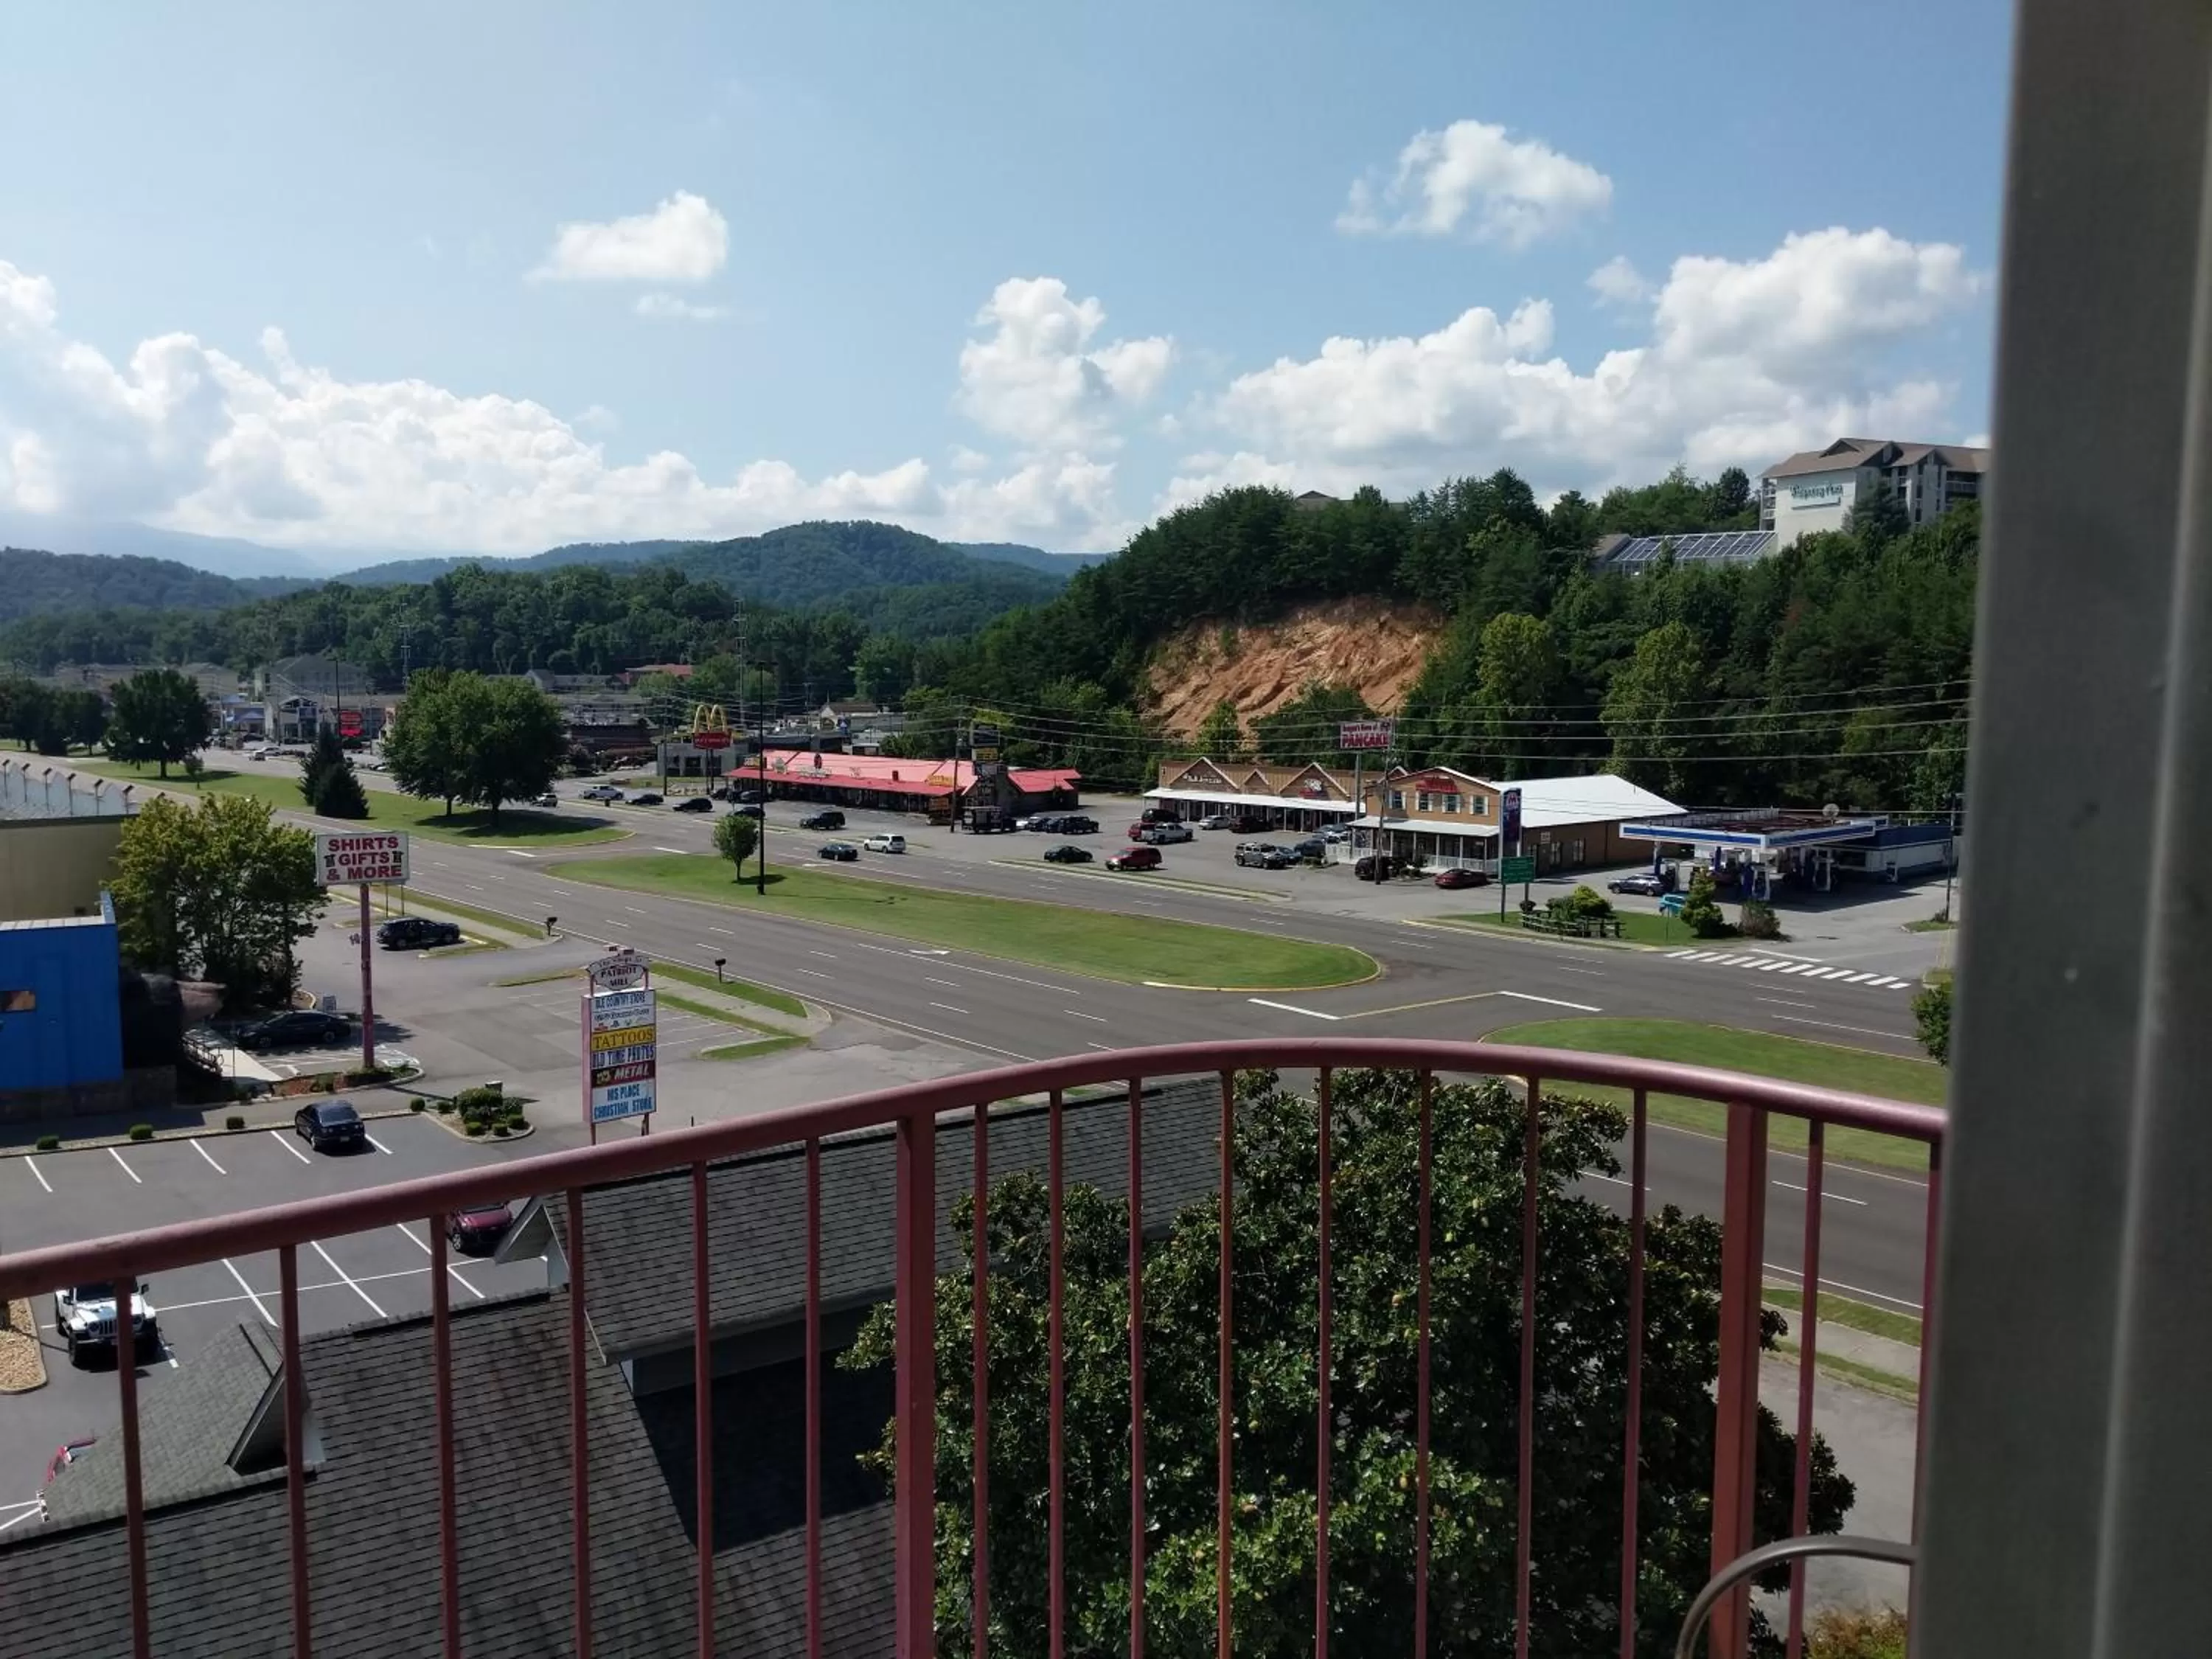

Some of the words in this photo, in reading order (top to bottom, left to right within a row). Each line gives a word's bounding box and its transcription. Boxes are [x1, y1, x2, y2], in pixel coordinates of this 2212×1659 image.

[328, 836, 399, 852] SHIRTS
[338, 852, 390, 866] GIFTS
[327, 869, 341, 880] &
[347, 865, 402, 880] MORE
[600, 967, 637, 978] PATRIOT
[610, 978, 627, 986] MILL
[594, 1029, 653, 1048] TATTOOS
[614, 1064, 650, 1080] METAL
[620, 1083, 641, 1099] PLACE
[594, 1102, 628, 1119] CHRISTIAN
[632, 1096, 653, 1112] STORE
